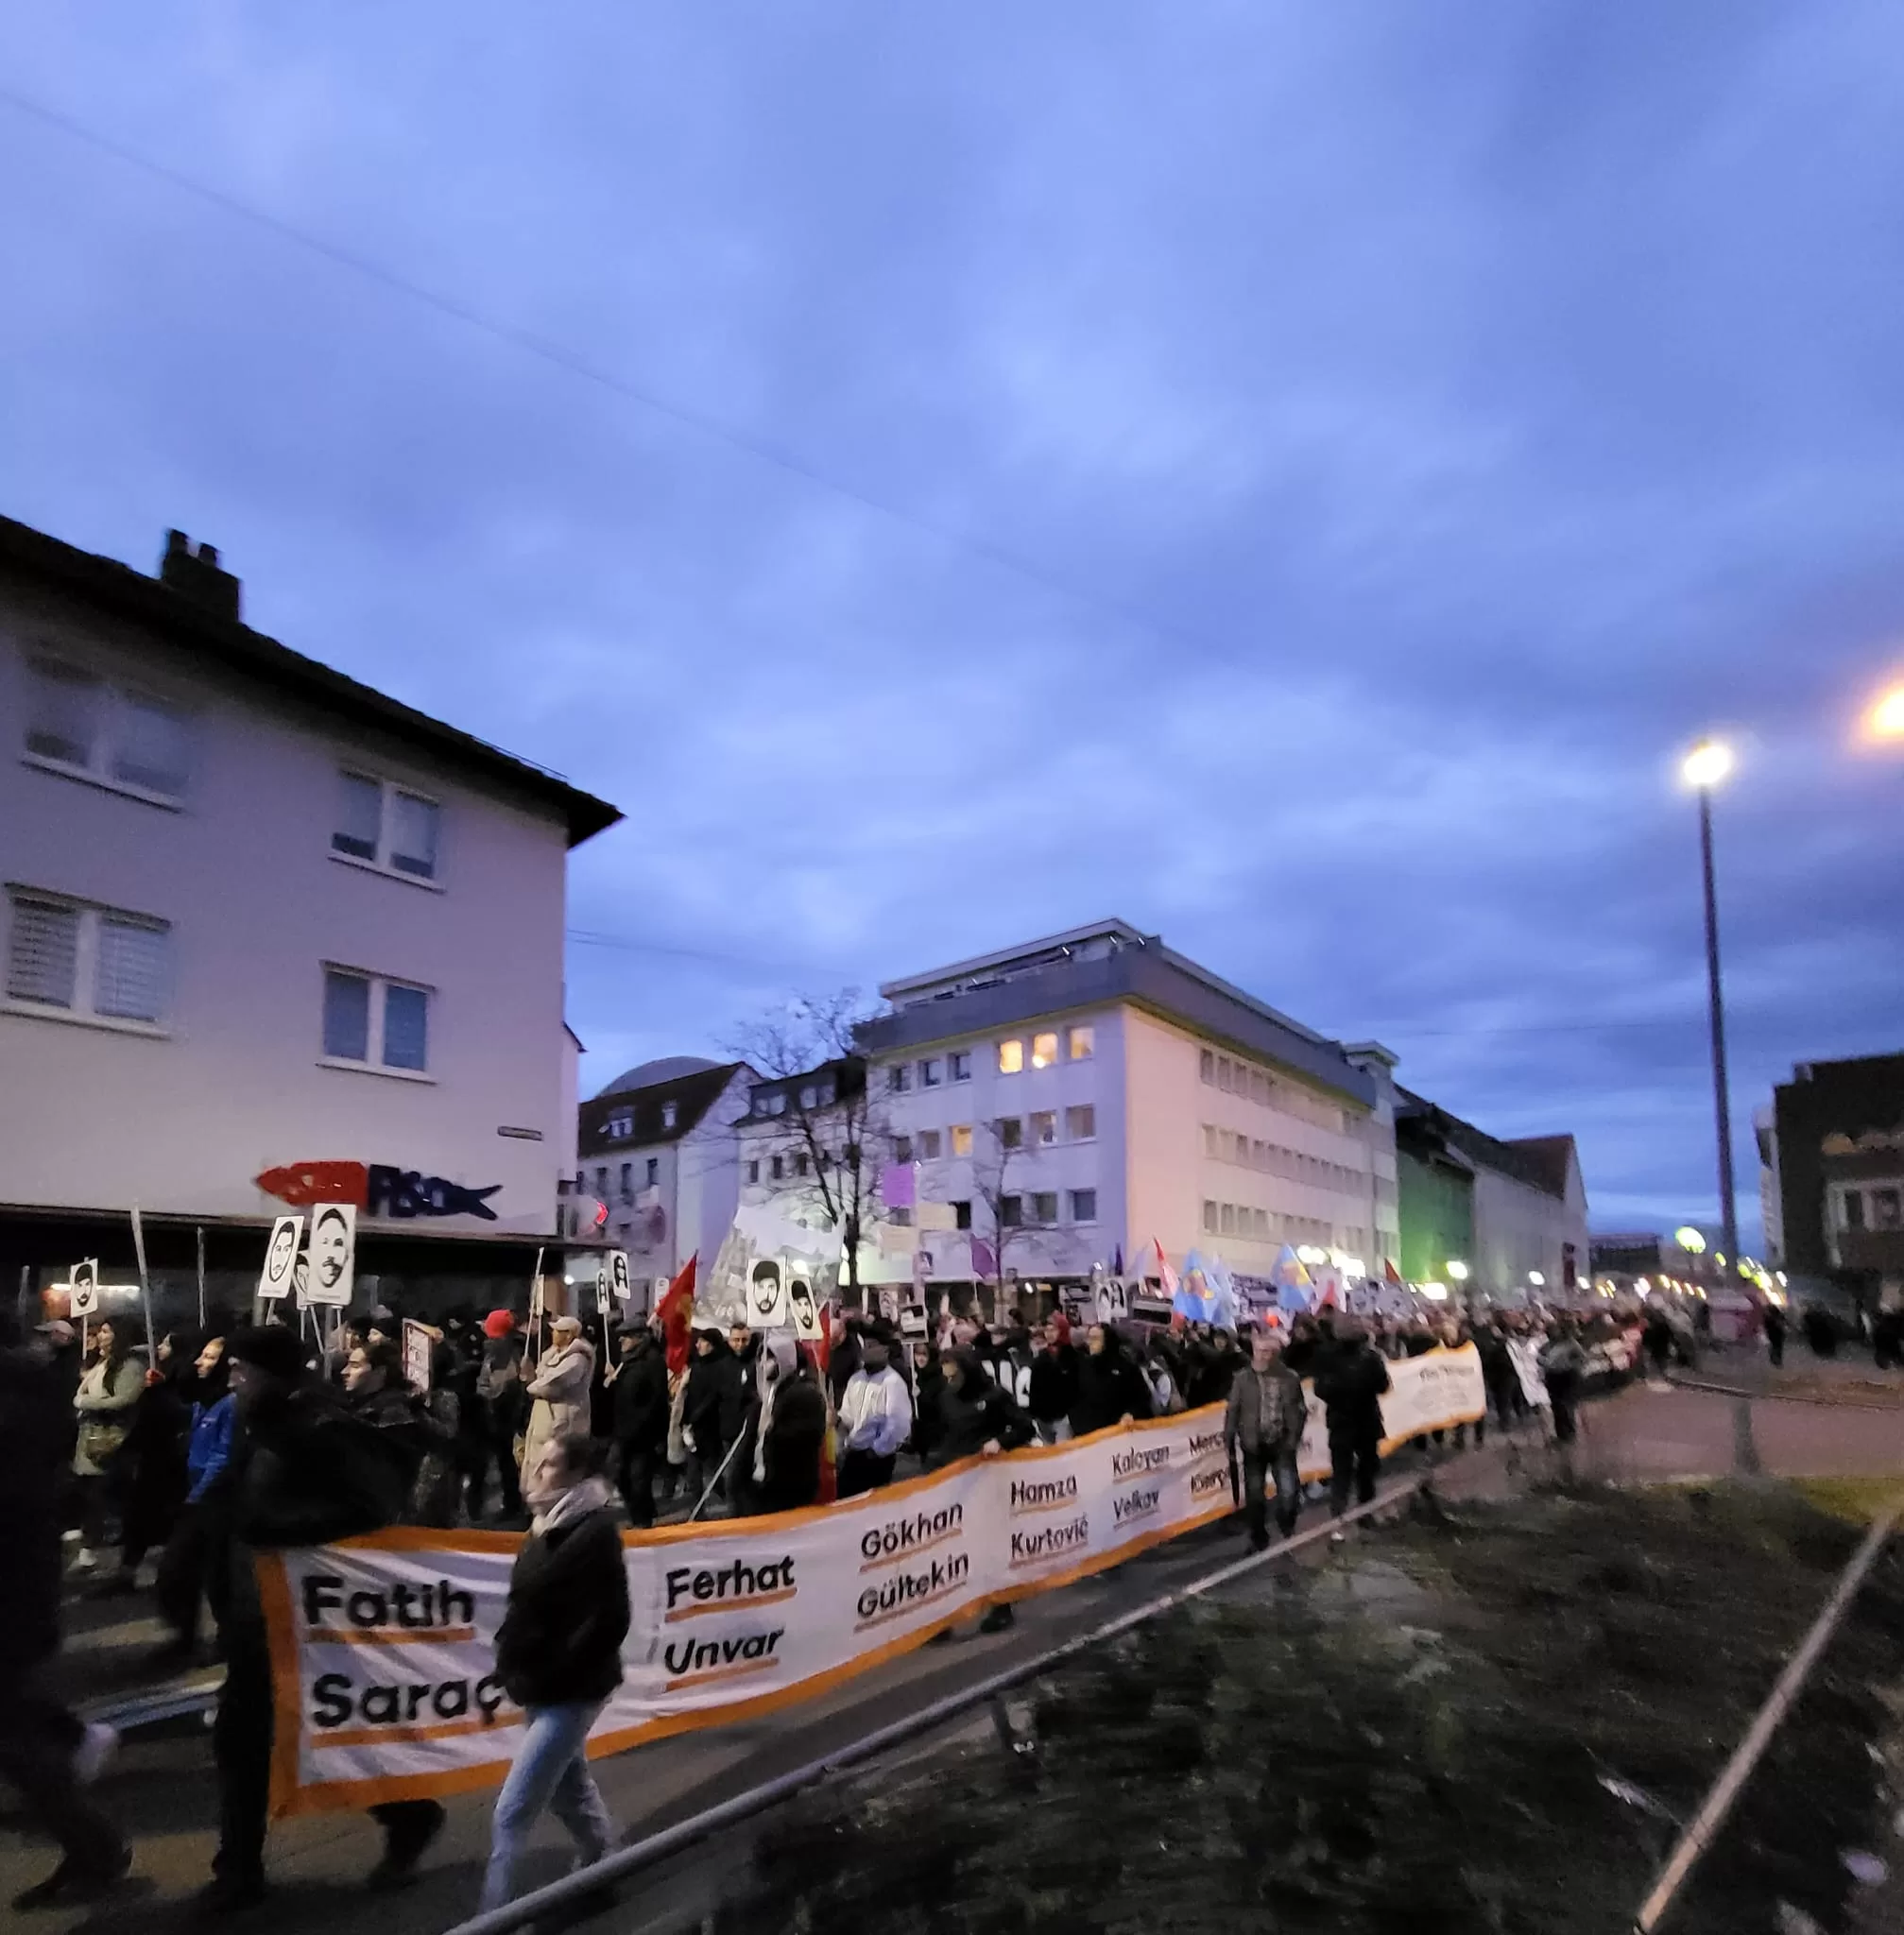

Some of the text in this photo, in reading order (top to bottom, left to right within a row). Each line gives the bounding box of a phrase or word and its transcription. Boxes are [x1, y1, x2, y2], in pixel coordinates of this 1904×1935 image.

[1112, 1447, 1170, 1476] Kaloyan
[1189, 1430, 1225, 1456] Merc
[1010, 1475, 1078, 1506] Hamza
[1191, 1467, 1228, 1494] Kierp
[1113, 1489, 1160, 1520] Velkov
[861, 1502, 964, 1559] Gökhan
[1010, 1515, 1089, 1559] Kurtović
[301, 1575, 476, 1627] Fatih
[665, 1555, 796, 1609] Ferhat
[856, 1552, 969, 1618] Gültekin
[664, 1628, 785, 1675] Unvar
[313, 1672, 505, 1725] Saraç
